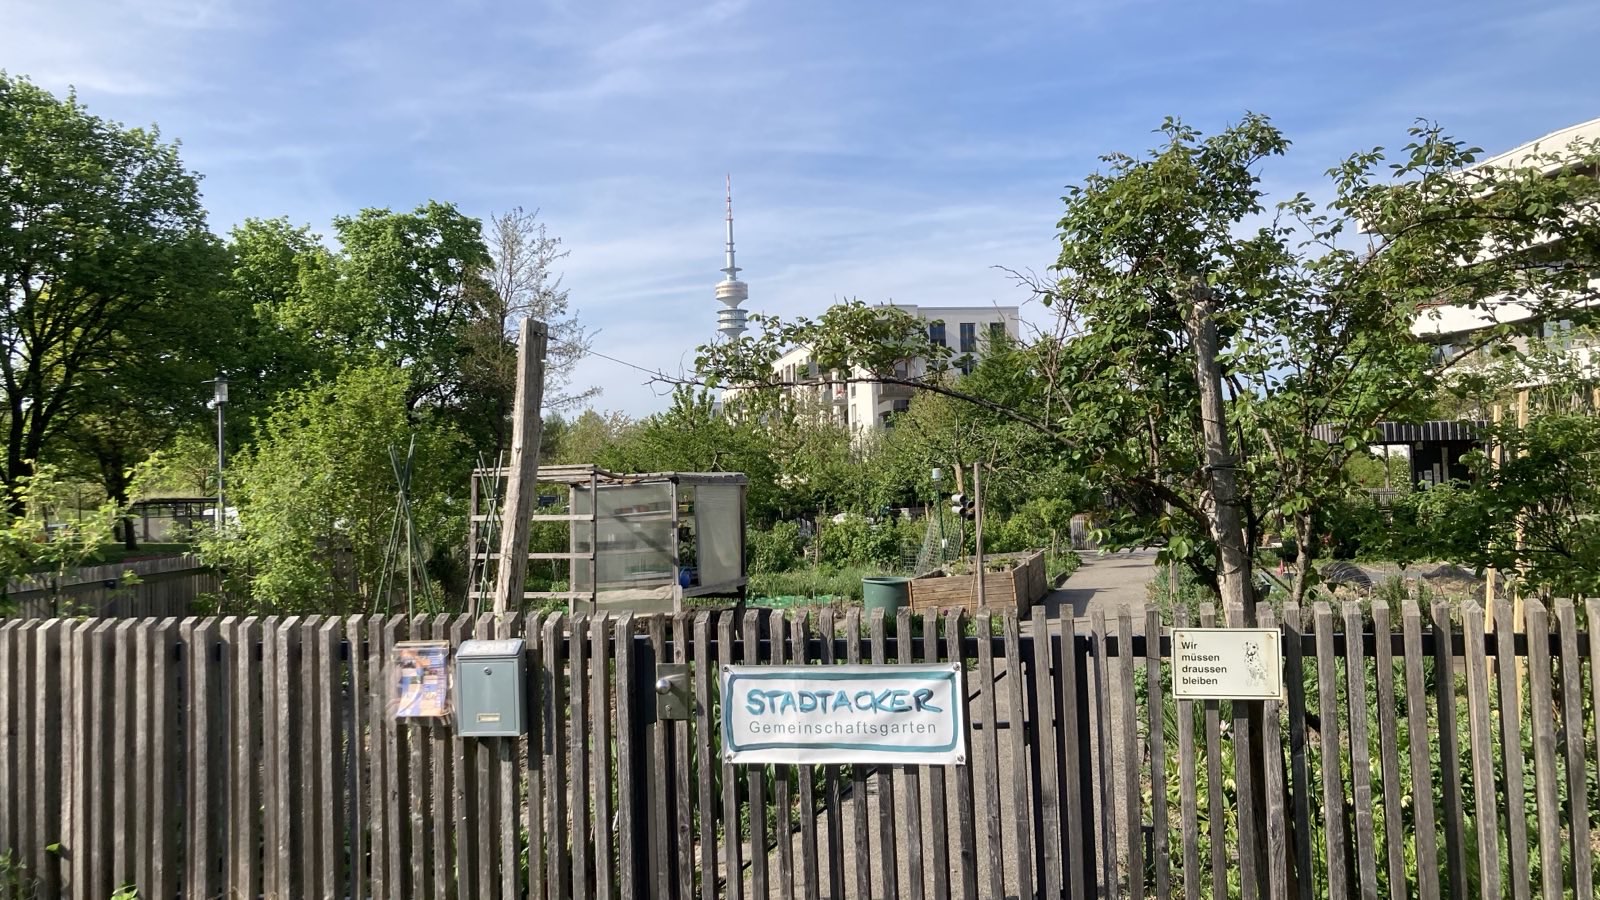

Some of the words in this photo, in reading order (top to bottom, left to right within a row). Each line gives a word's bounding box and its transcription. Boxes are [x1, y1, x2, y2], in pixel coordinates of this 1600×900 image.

[1181, 641, 1198, 650] Wir
[1181, 653, 1220, 662] müssen
[1182, 665, 1227, 673] draussen
[1182, 676, 1218, 685] bleiben
[745, 688, 943, 715] STADTACKER
[749, 720, 937, 736] Gemeinschaftsgarten
